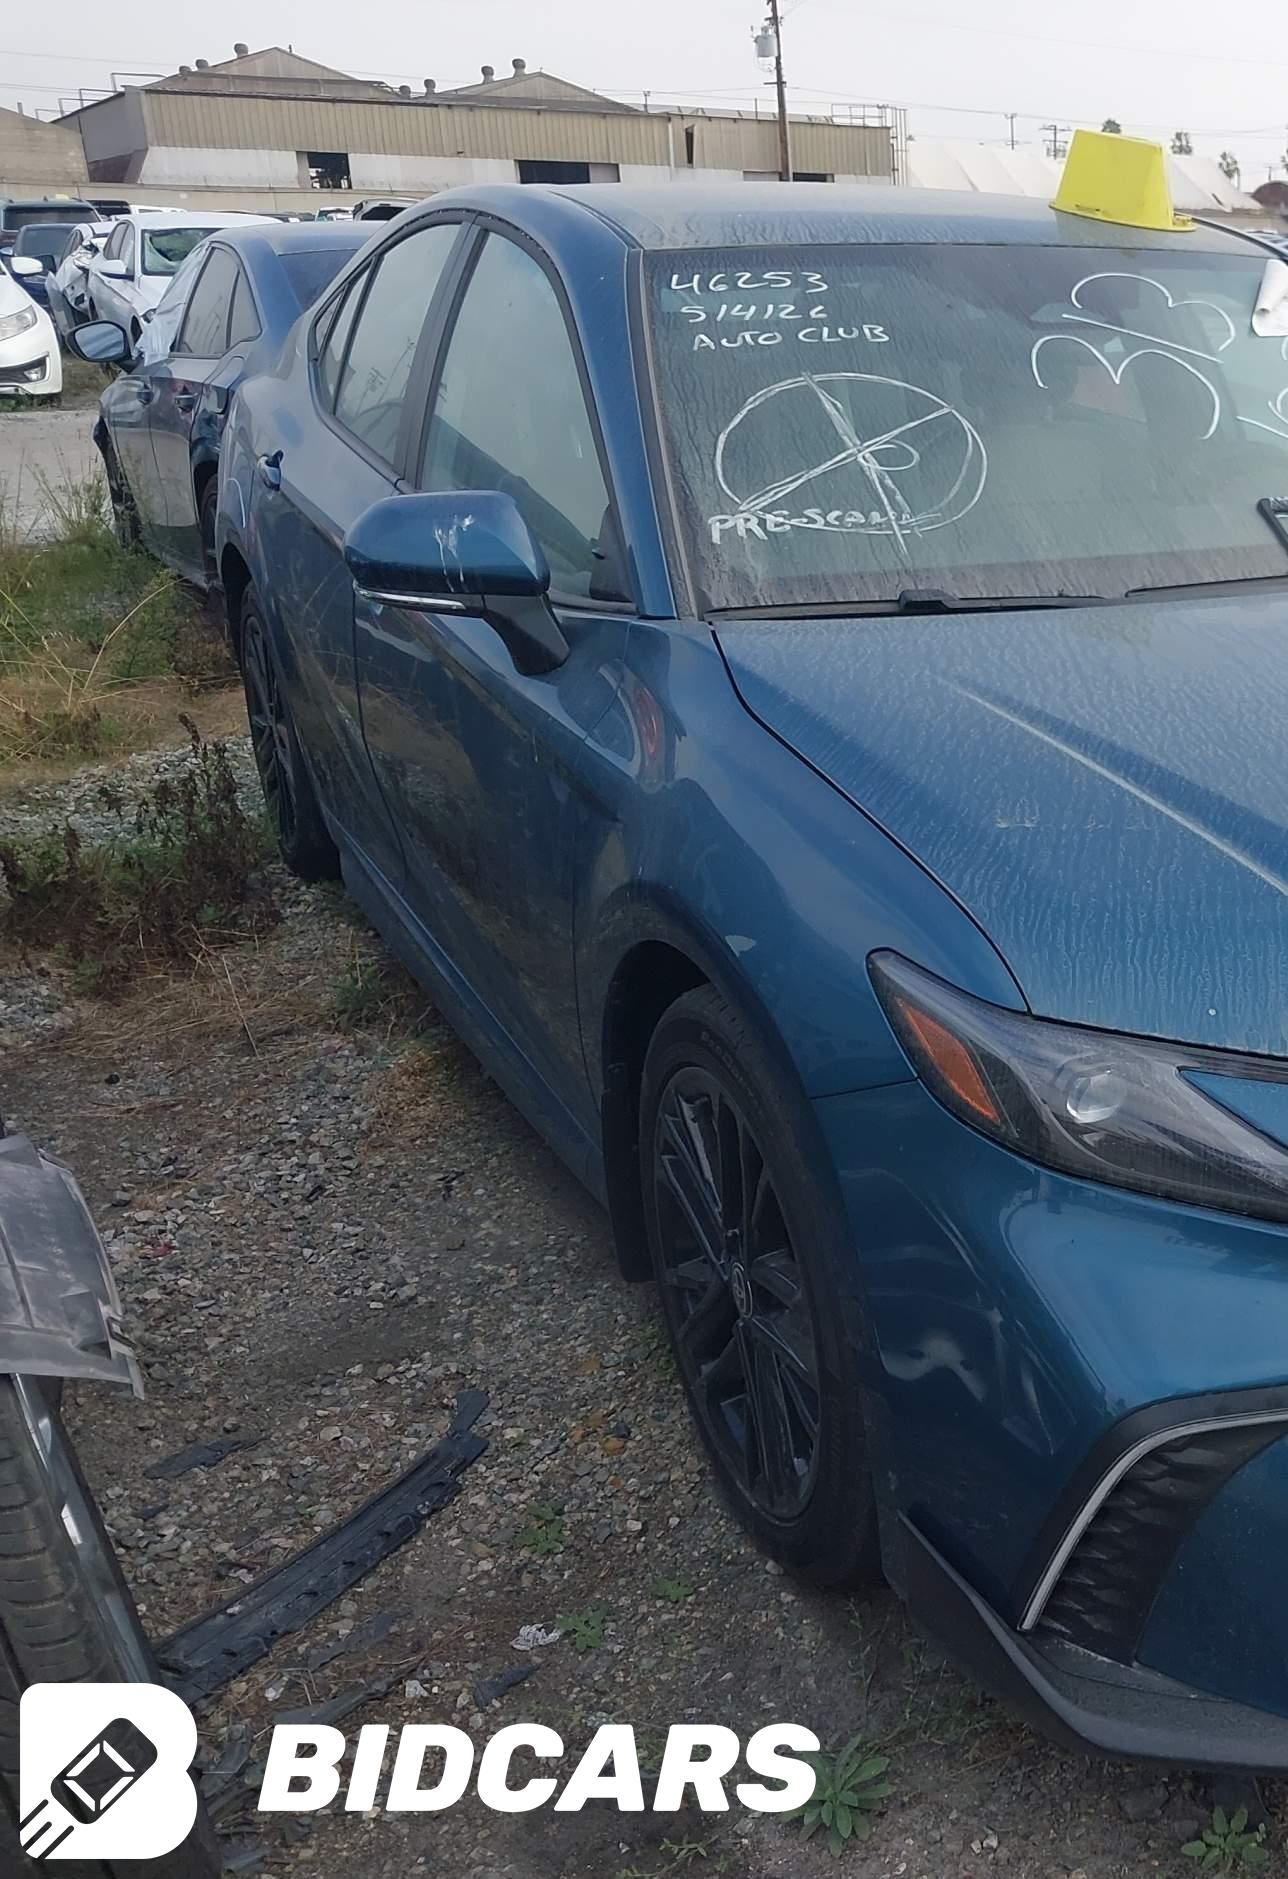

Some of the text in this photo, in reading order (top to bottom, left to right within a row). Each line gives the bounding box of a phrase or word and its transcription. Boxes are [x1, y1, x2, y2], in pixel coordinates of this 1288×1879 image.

[670, 271, 829, 296] 46253
[692, 324, 891, 351] AUTO CLUB
